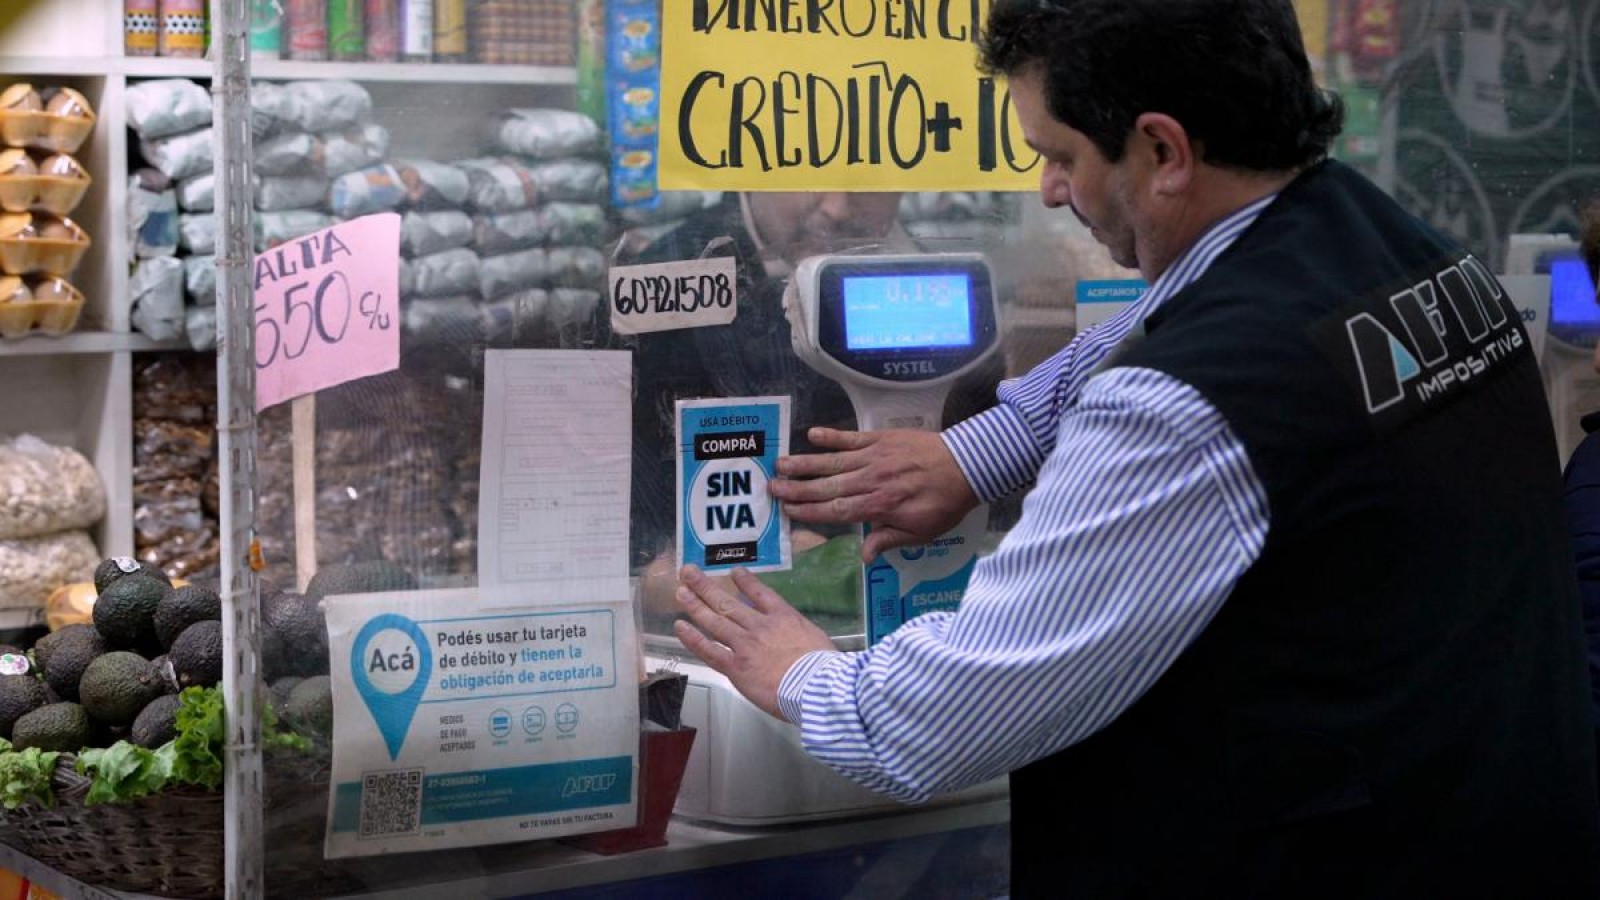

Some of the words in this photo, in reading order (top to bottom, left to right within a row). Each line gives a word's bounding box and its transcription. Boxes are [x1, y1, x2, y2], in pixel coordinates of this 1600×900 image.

[884, 0, 927, 40] EN
[255, 230, 352, 290] ALTA
[883, 361, 937, 375] SYSTEL
[702, 434, 757, 453] COMPRÁ
[707, 470, 752, 498] SIN
[706, 503, 756, 531] IVA
[911, 590, 962, 607] ESCANE
[437, 631, 483, 647] Podés
[487, 630, 518, 645] usar
[523, 627, 537, 642] tu
[540, 624, 587, 643] tarjeta
[369, 646, 415, 673] Acá
[439, 653, 457, 669] de
[461, 650, 505, 668] débito
[510, 651, 517, 666] y
[520, 648, 565, 663] tienen
[569, 645, 583, 659] la
[439, 670, 514, 691] obligación
[518, 668, 535, 684] de
[540, 664, 604, 683] aceptarla
